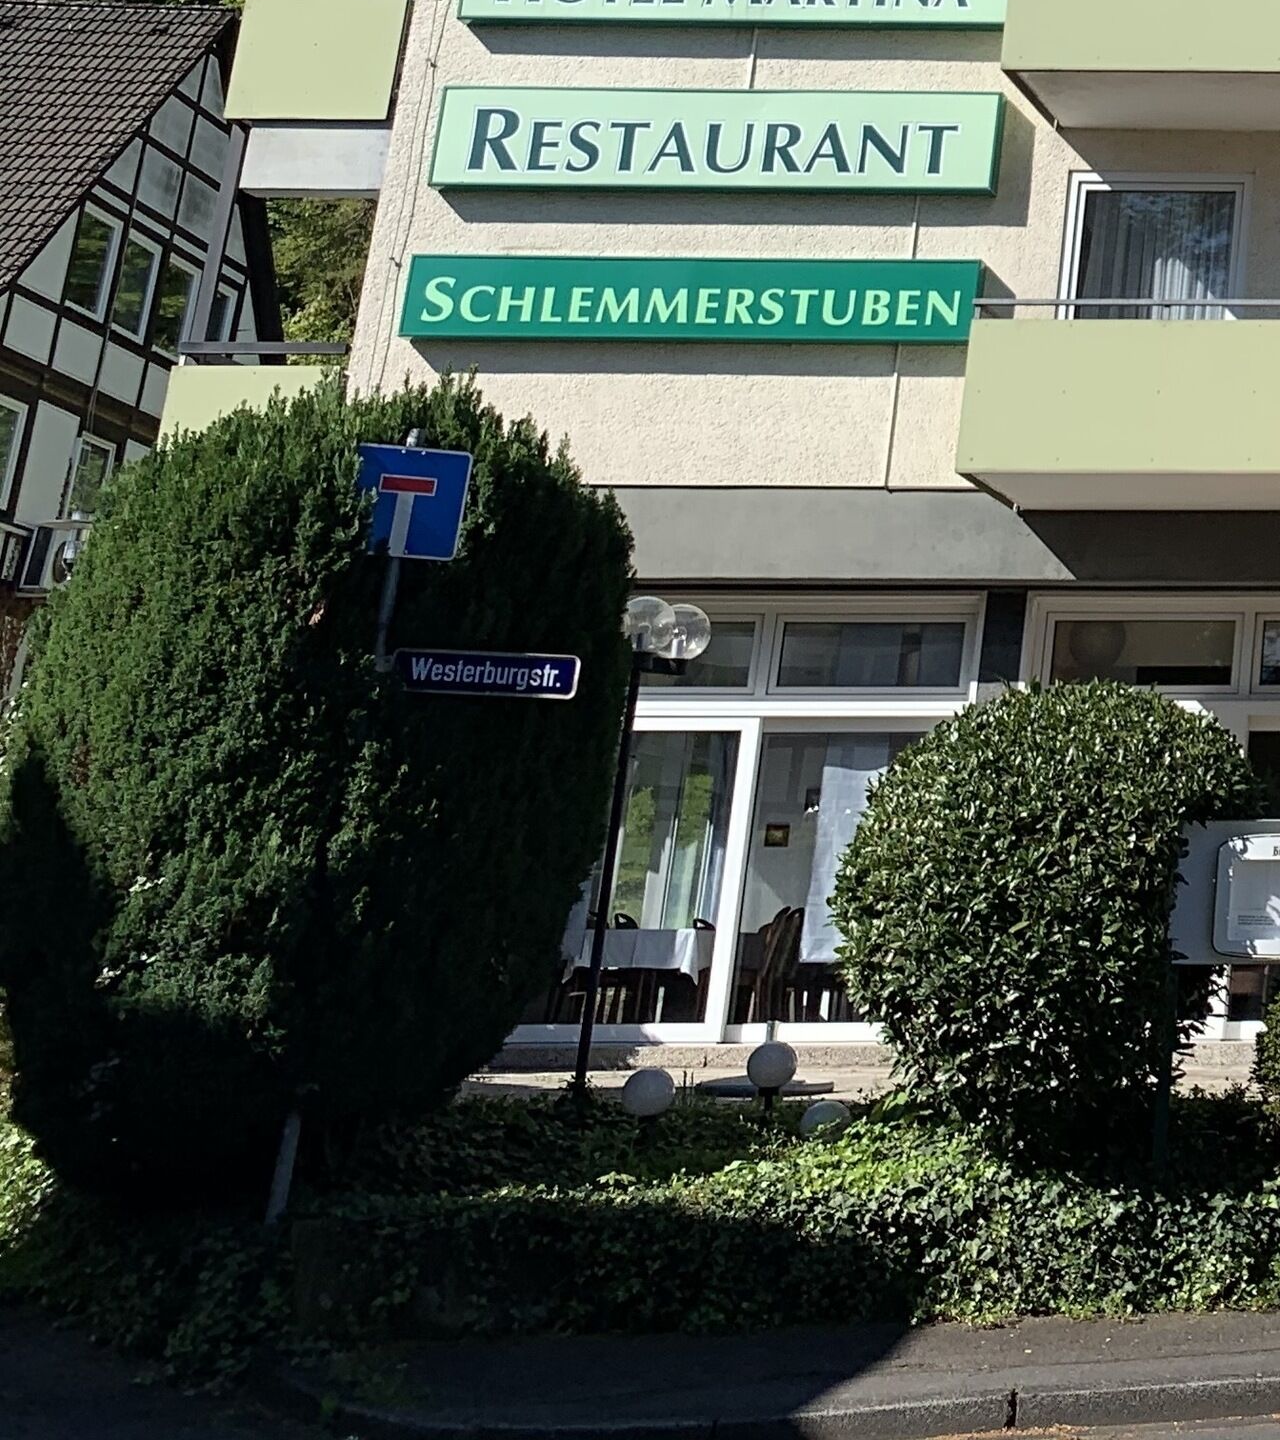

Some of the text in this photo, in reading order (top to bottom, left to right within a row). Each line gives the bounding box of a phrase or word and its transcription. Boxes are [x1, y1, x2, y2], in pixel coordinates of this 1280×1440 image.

[466, 108, 960, 175] RESTAURANT
[421, 276, 962, 326] SCHLEMMERSTUBEN
[411, 657, 561, 690] Westerburgstr.
